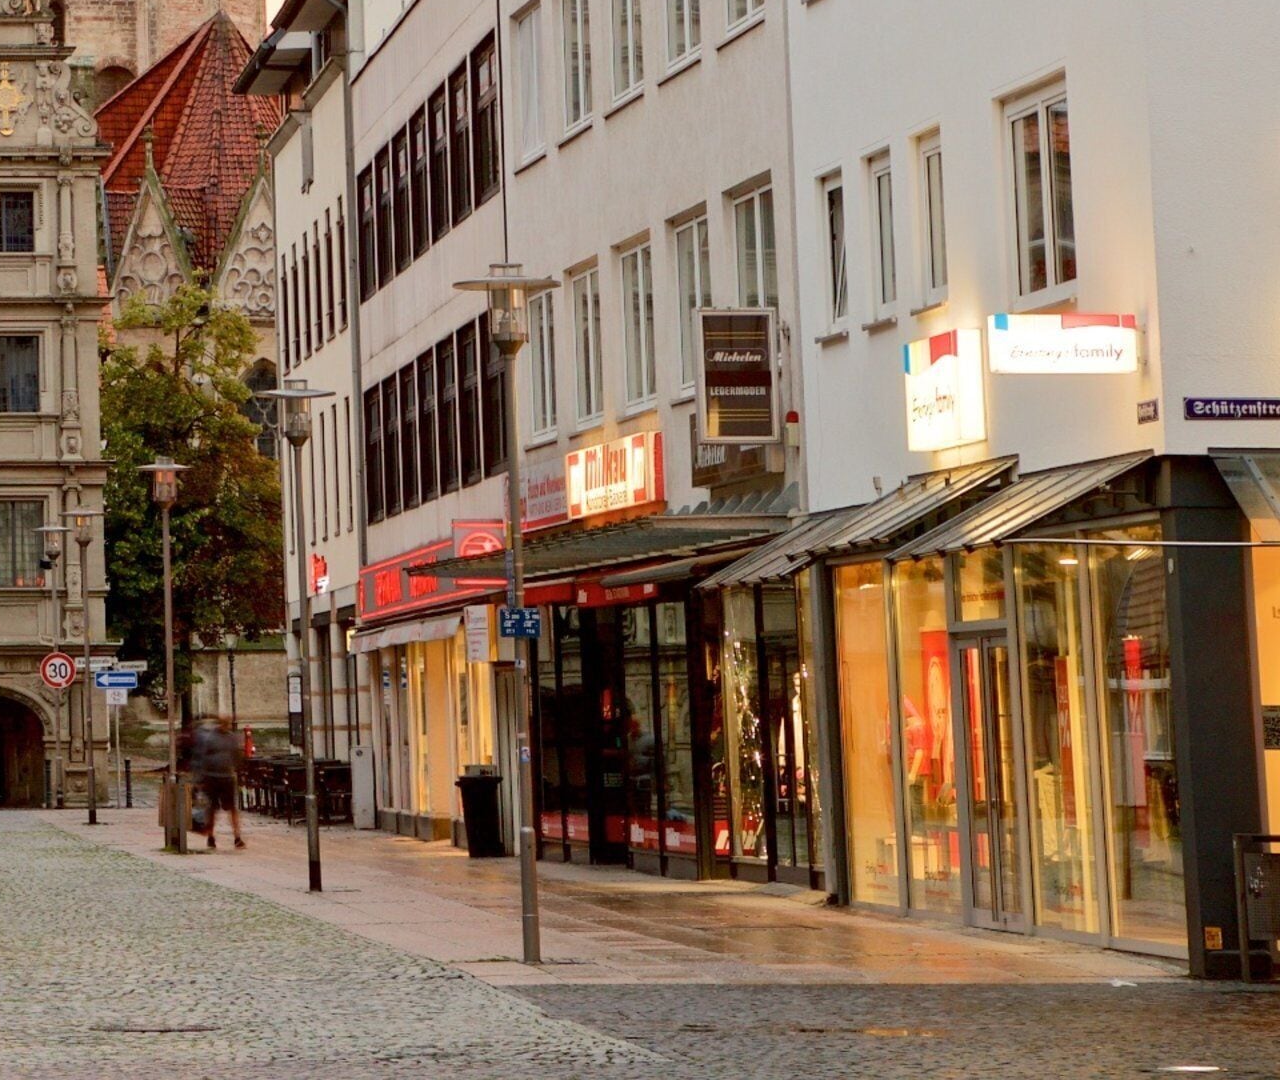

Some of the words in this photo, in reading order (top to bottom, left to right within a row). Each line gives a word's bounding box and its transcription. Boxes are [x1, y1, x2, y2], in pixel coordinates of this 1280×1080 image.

[1074, 343, 1125, 361] family
[709, 386, 767, 397] LEDERMODEN
[48, 662, 69, 680] 30
